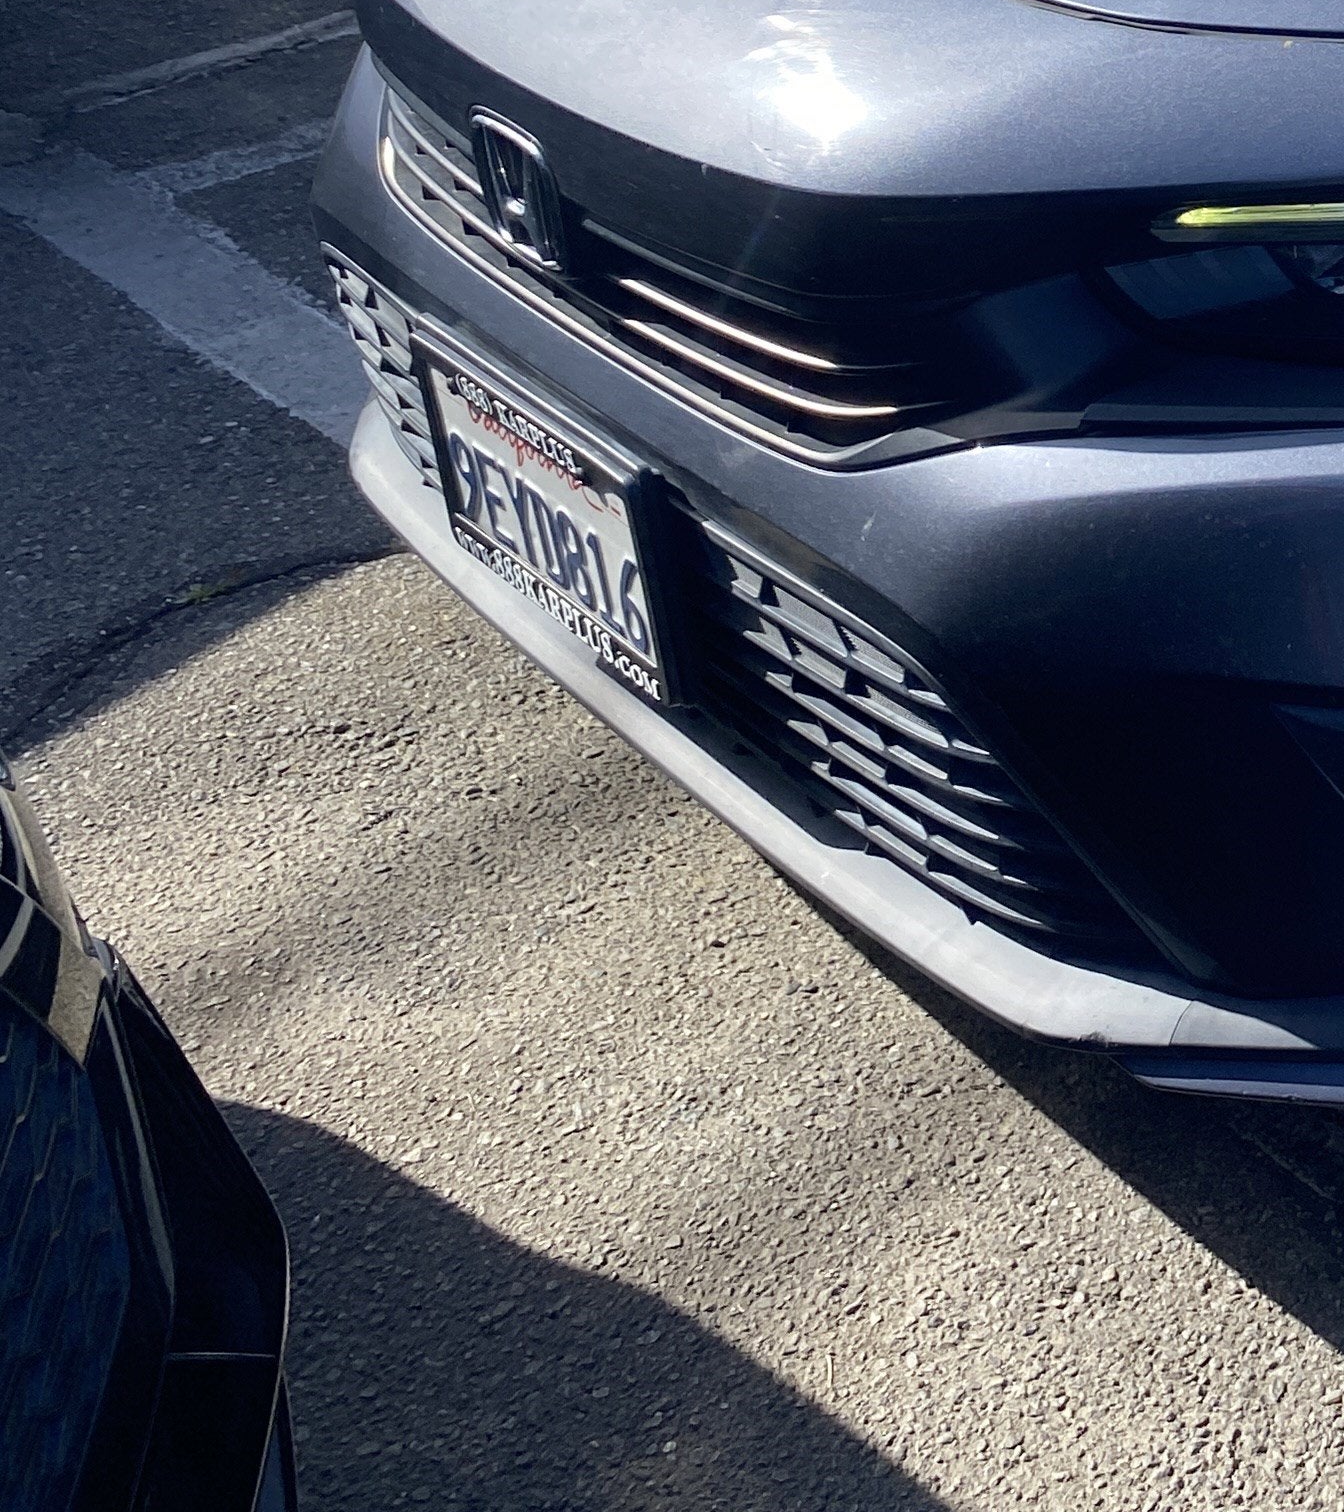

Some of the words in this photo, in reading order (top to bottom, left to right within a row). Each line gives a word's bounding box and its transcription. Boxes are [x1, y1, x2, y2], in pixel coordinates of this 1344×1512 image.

[455, 372, 493, 416] (888)
[493, 399, 577, 474] KARPLUS
[449, 431, 648, 656] 9EYD816
